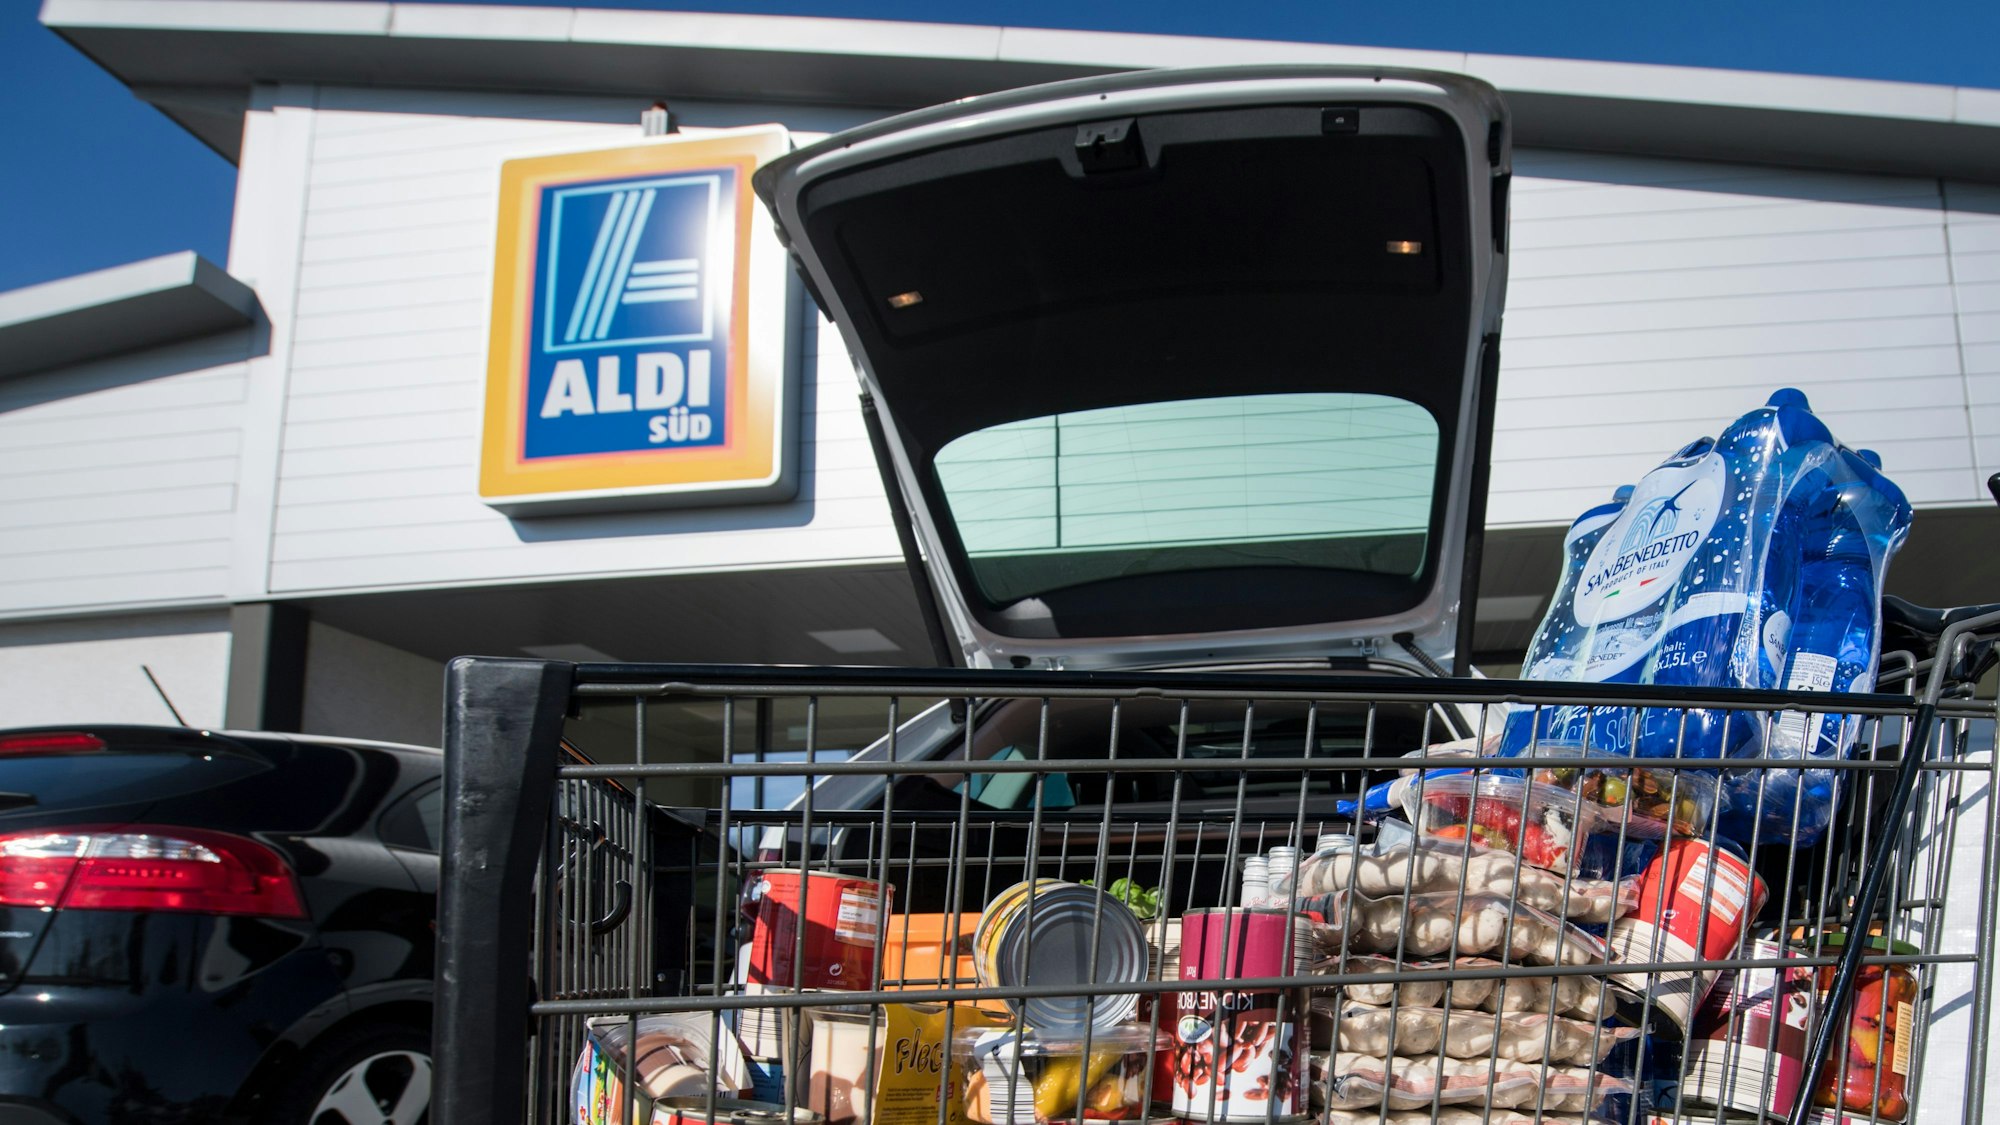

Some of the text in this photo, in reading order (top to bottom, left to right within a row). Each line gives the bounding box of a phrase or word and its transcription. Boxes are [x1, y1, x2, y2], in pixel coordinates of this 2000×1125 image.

[540, 349, 711, 418] ALDI
[649, 406, 711, 443] SÜD
[1600, 559, 1671, 592] PRODUCT OF ITALY
